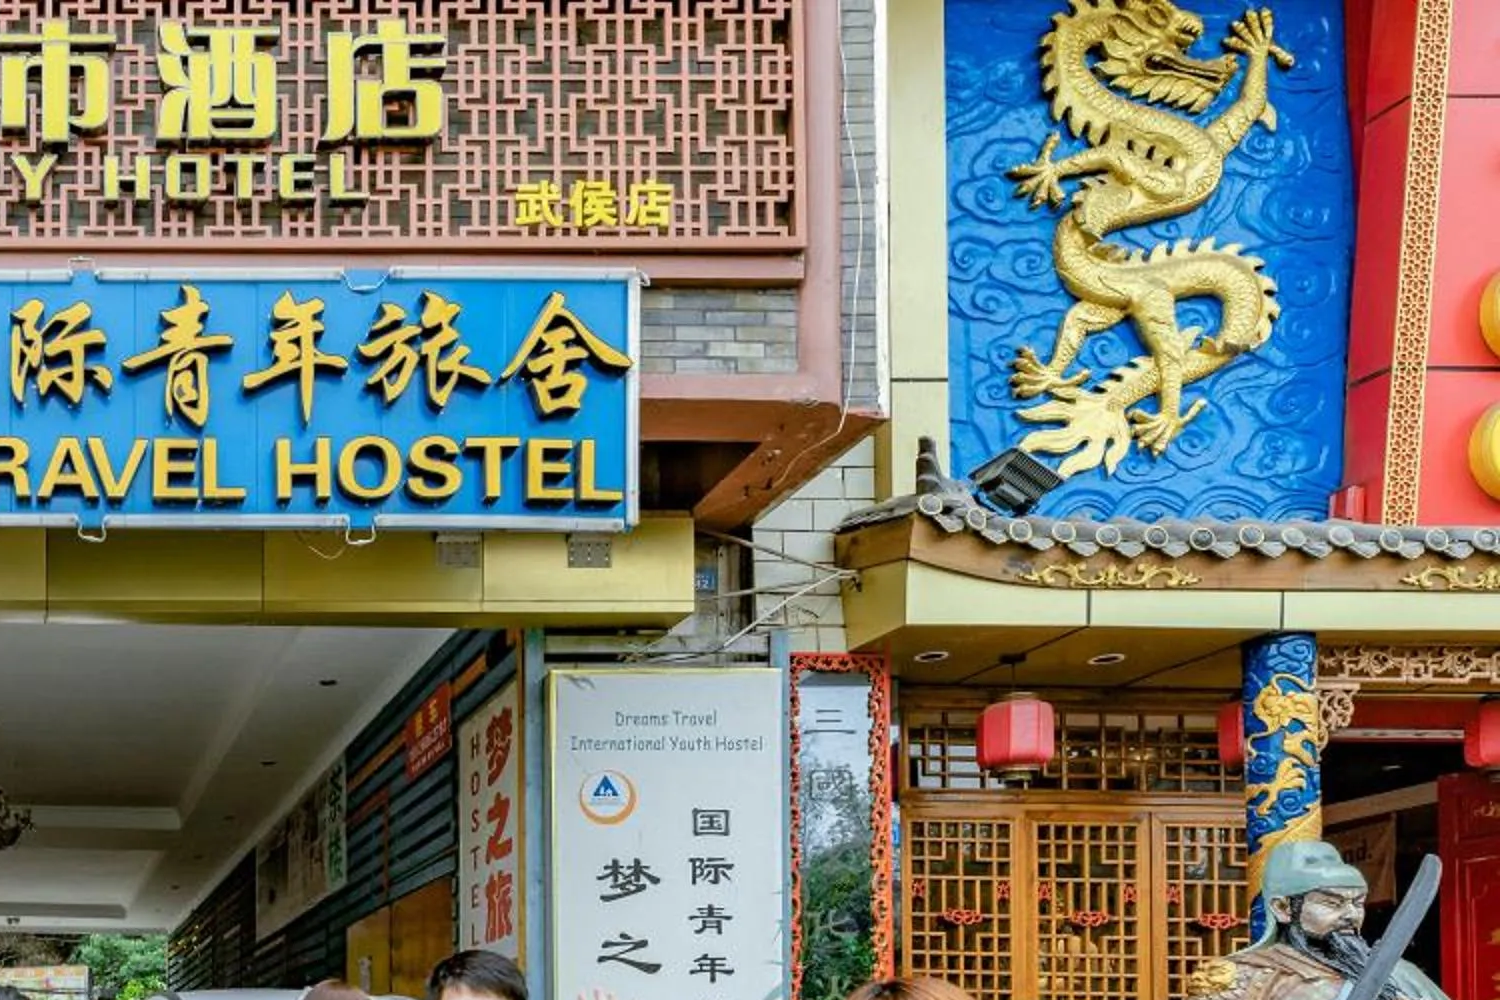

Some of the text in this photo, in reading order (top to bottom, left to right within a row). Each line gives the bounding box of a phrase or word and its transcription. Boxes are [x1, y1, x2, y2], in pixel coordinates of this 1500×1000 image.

[103, 153, 370, 206] HOTEL
[514, 180, 674, 228] 武侯店
[276, 435, 625, 505] HOSTEL
[571, 734, 764, 751] International Youth Hostel
[615, 708, 717, 727] Dreams Travel
[471, 731, 481, 947] HOSTEL
[485, 705, 513, 944] 梦之旅
